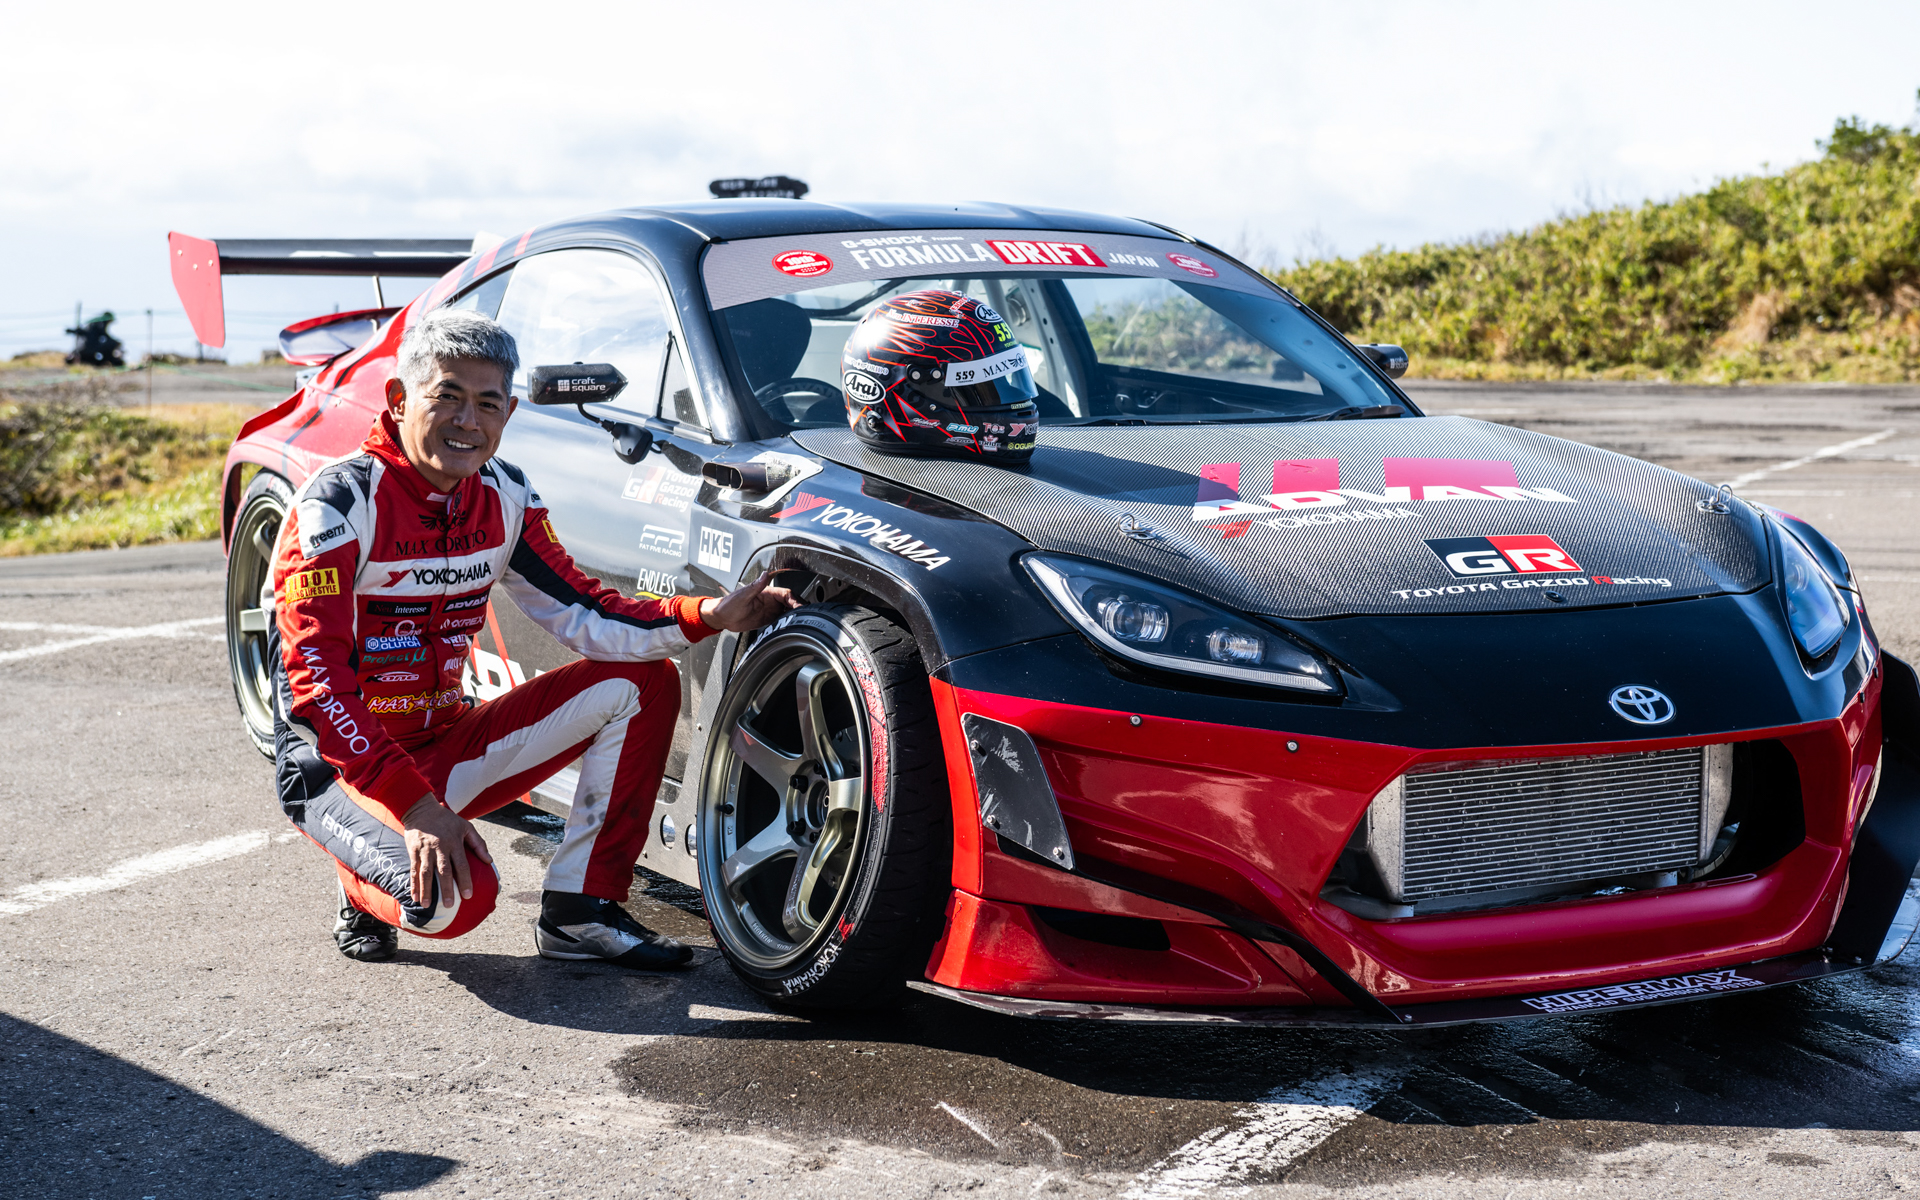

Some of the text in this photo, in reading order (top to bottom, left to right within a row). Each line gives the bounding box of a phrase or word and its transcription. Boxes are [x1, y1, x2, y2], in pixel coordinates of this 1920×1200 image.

[841, 235, 928, 249] G-SHOCK
[850, 241, 1160, 270] FORMULA DRIFT JAPAN
[903, 313, 960, 328] INTERESSE
[571, 376, 596, 385] craft
[955, 360, 1010, 381] 559 MAX
[571, 384, 606, 392] square
[846, 375, 879, 397] Arai
[665, 469, 704, 486] TOYOTA
[623, 477, 657, 500] GR
[659, 481, 695, 498] GAZOO
[654, 493, 690, 513] Racing
[1193, 485, 1578, 521] ADVAN
[308, 523, 347, 549] freem
[700, 526, 733, 560] HKS
[811, 503, 952, 572] YOKOHAMA
[395, 539, 429, 557] MAX
[639, 542, 682, 558] FAT FIVE RACING
[1445, 549, 1577, 575] GR
[412, 561, 492, 586] YOKOHAMA
[636, 568, 678, 597] ENDLESS
[1392, 575, 1672, 600] TOYOTA GAZOO Racing
[394, 605, 427, 614] interesse
[444, 596, 487, 611] ADVAN
[380, 640, 422, 650] CLUTCH
[361, 651, 411, 665] Project
[301, 646, 370, 755] MAX ORIDO
[368, 696, 412, 711] MAX
[363, 842, 413, 898] YOKOHAM
[1521, 969, 1753, 1010] HIPERMAX
[1710, 980, 1766, 991] SYSTEM
